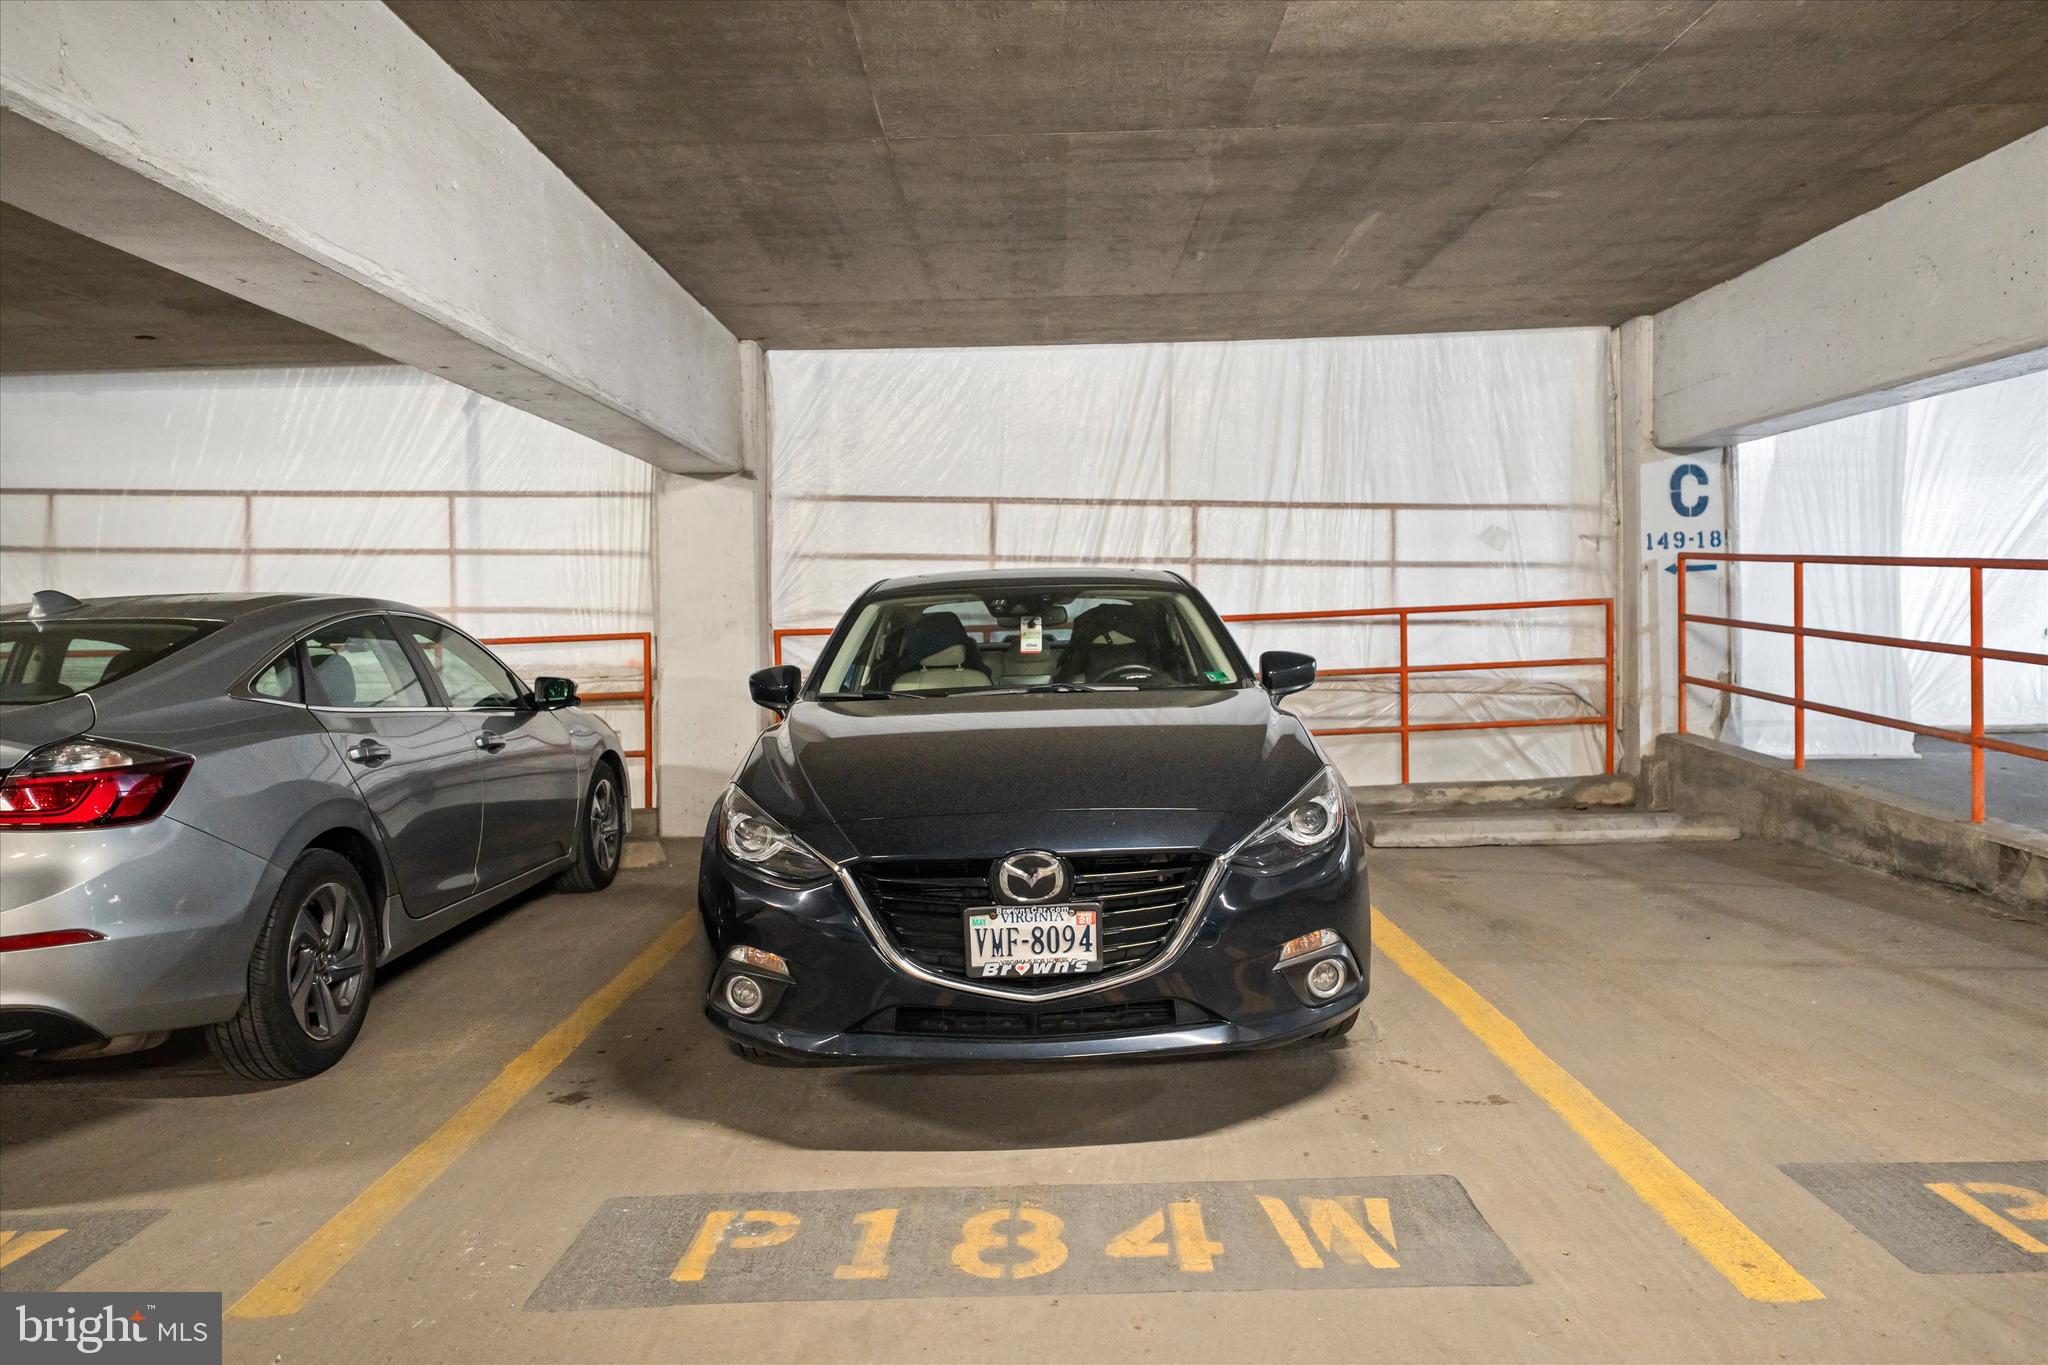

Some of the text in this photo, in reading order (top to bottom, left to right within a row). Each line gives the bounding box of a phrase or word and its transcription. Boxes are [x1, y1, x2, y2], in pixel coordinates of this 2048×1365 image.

[1670, 464, 1709, 517] C
[1646, 529, 1728, 550] 149-18
[972, 918, 987, 926] MAY
[1001, 911, 1064, 923] VIRGINIA
[974, 925, 1093, 958] VMF-8094
